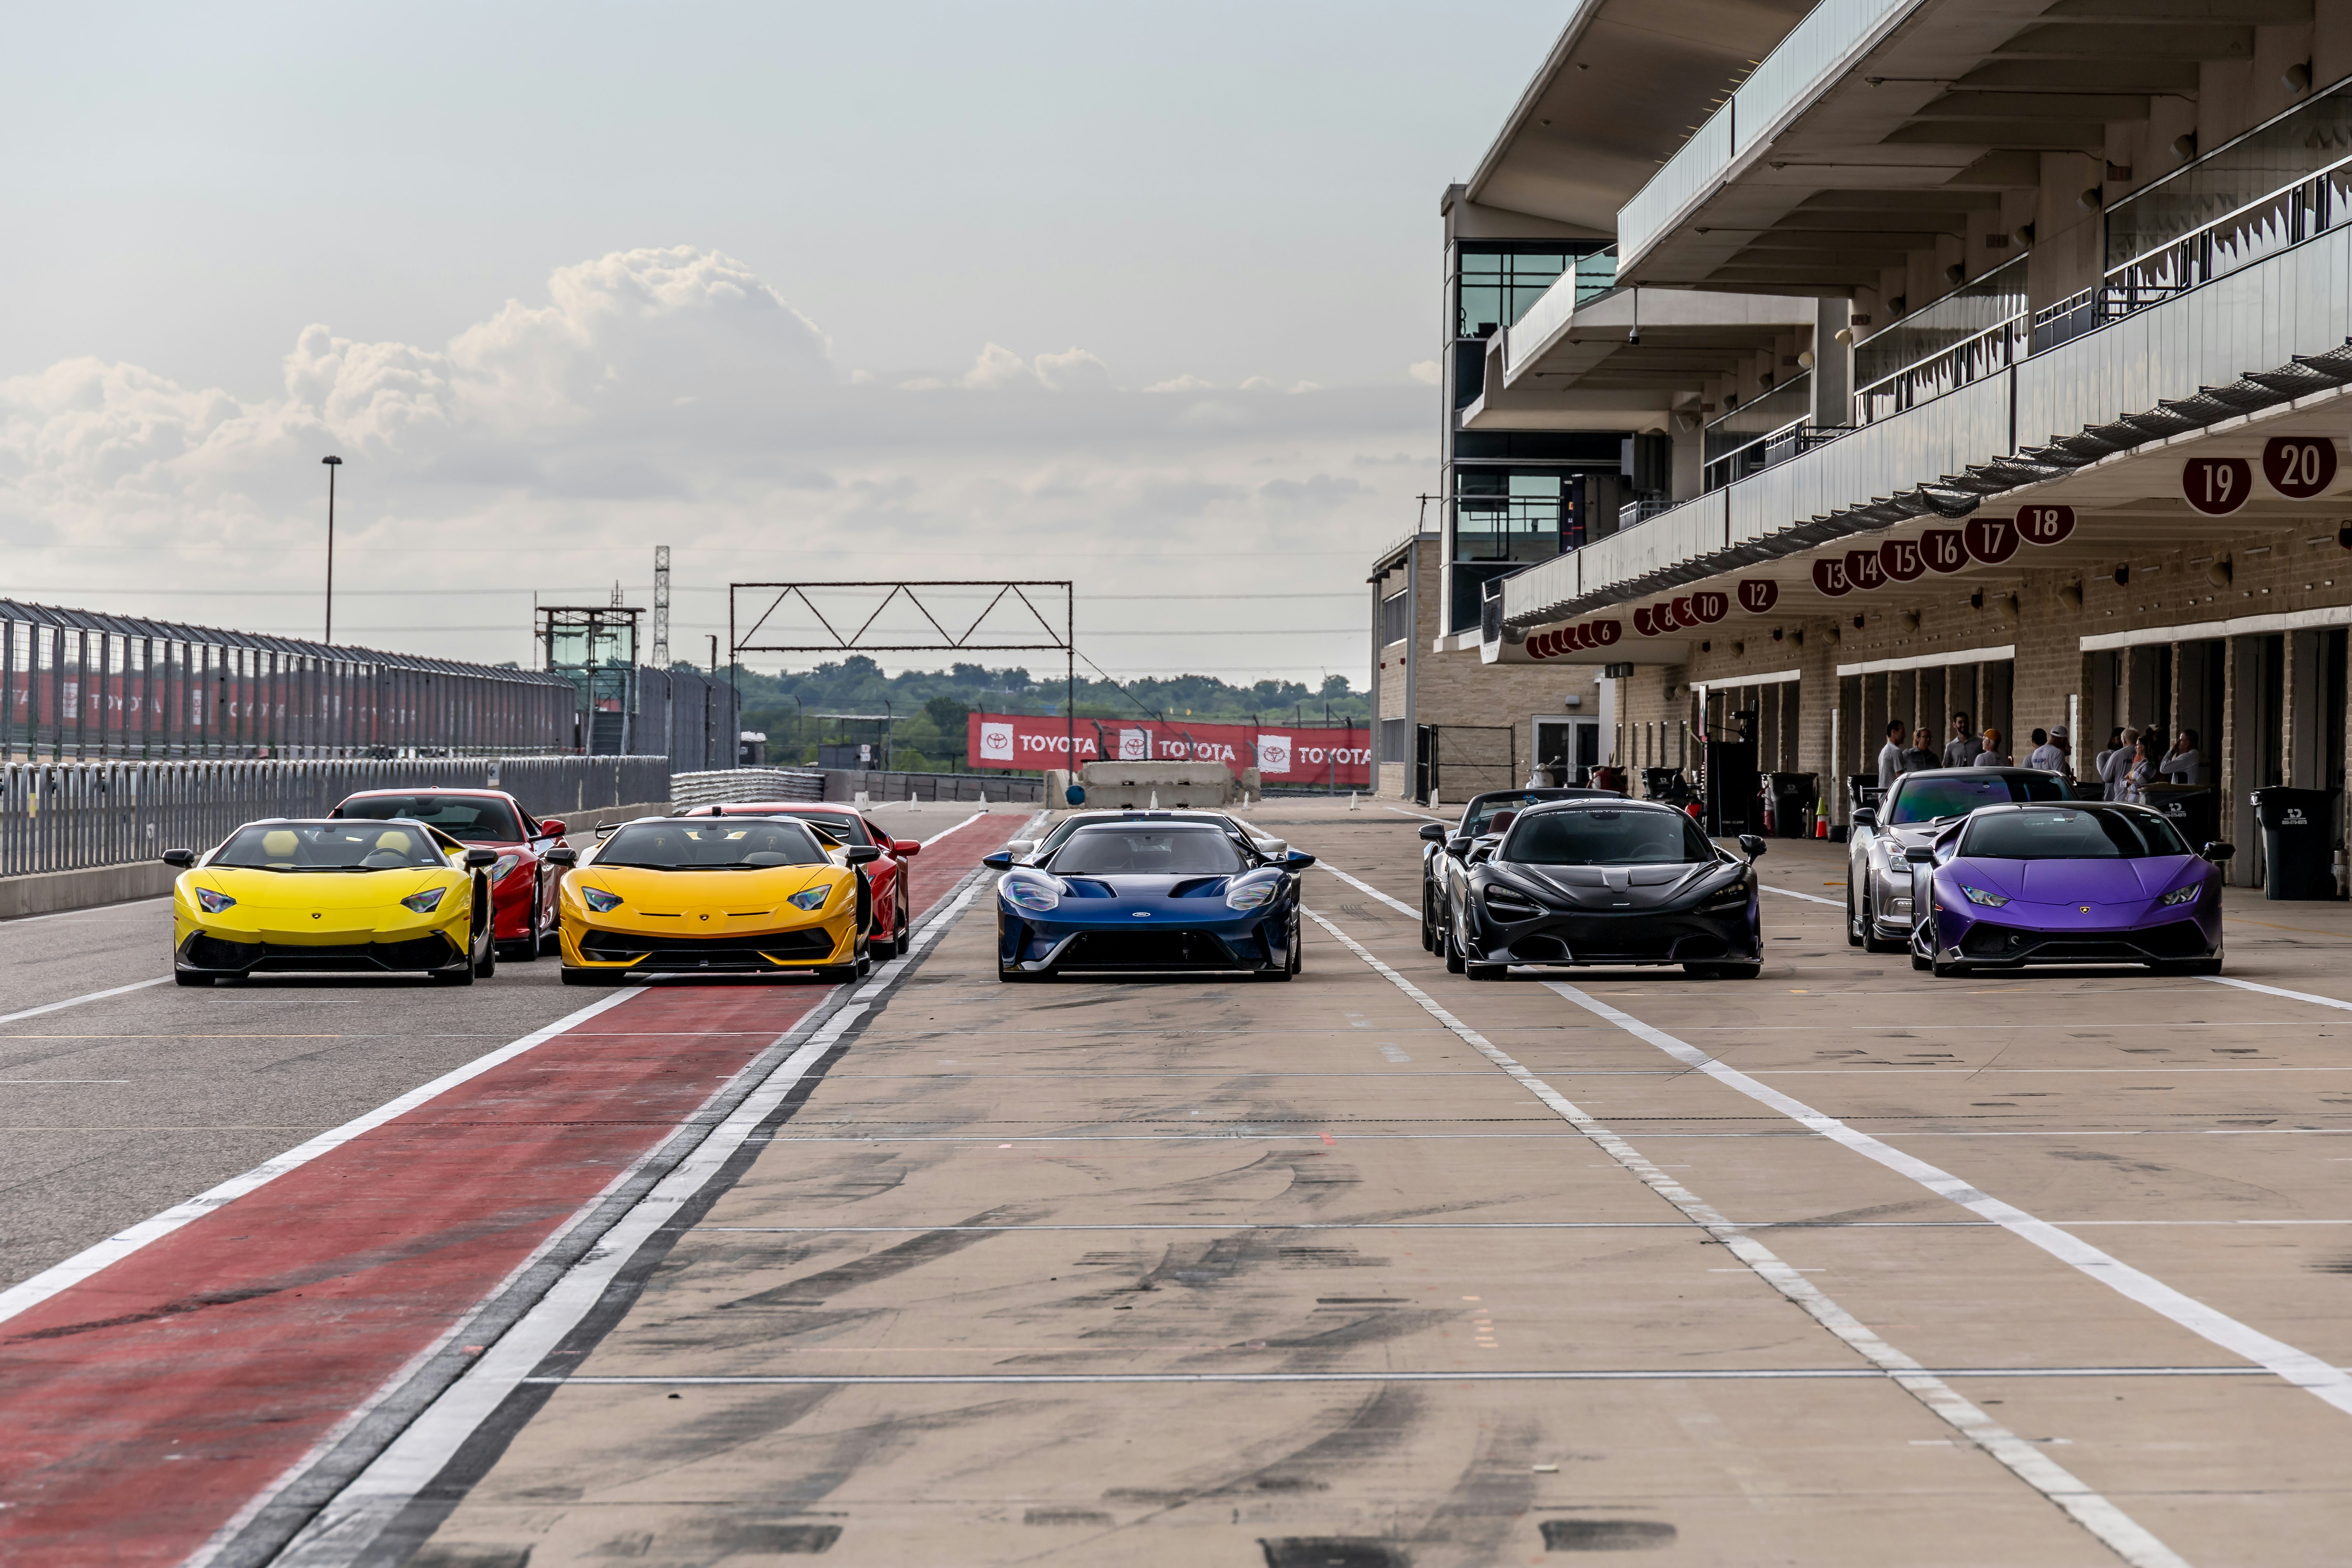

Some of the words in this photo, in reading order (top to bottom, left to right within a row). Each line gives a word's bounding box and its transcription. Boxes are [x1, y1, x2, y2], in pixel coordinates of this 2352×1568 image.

[2281, 445, 2320, 485] 20
[2203, 465, 2233, 502] 19
[2033, 510, 2058, 536] 18
[1935, 535, 1957, 564] 16
[1982, 524, 2005, 553] 17
[1858, 555, 1878, 581] 14
[1895, 545, 1915, 572] 15
[1826, 564, 1845, 588] 13
[1702, 596, 1719, 616] 10
[1750, 584, 1766, 606] 12
[1665, 607, 1673, 626] 8
[1683, 600, 1691, 619] 9
[1602, 624, 1610, 640] 6
[90, 694, 161, 713] TYOA
[1019, 735, 1097, 753] TOYOTA
[1158, 741, 1236, 761] TOYOTA
[1298, 747, 1371, 764] TOYOTA
